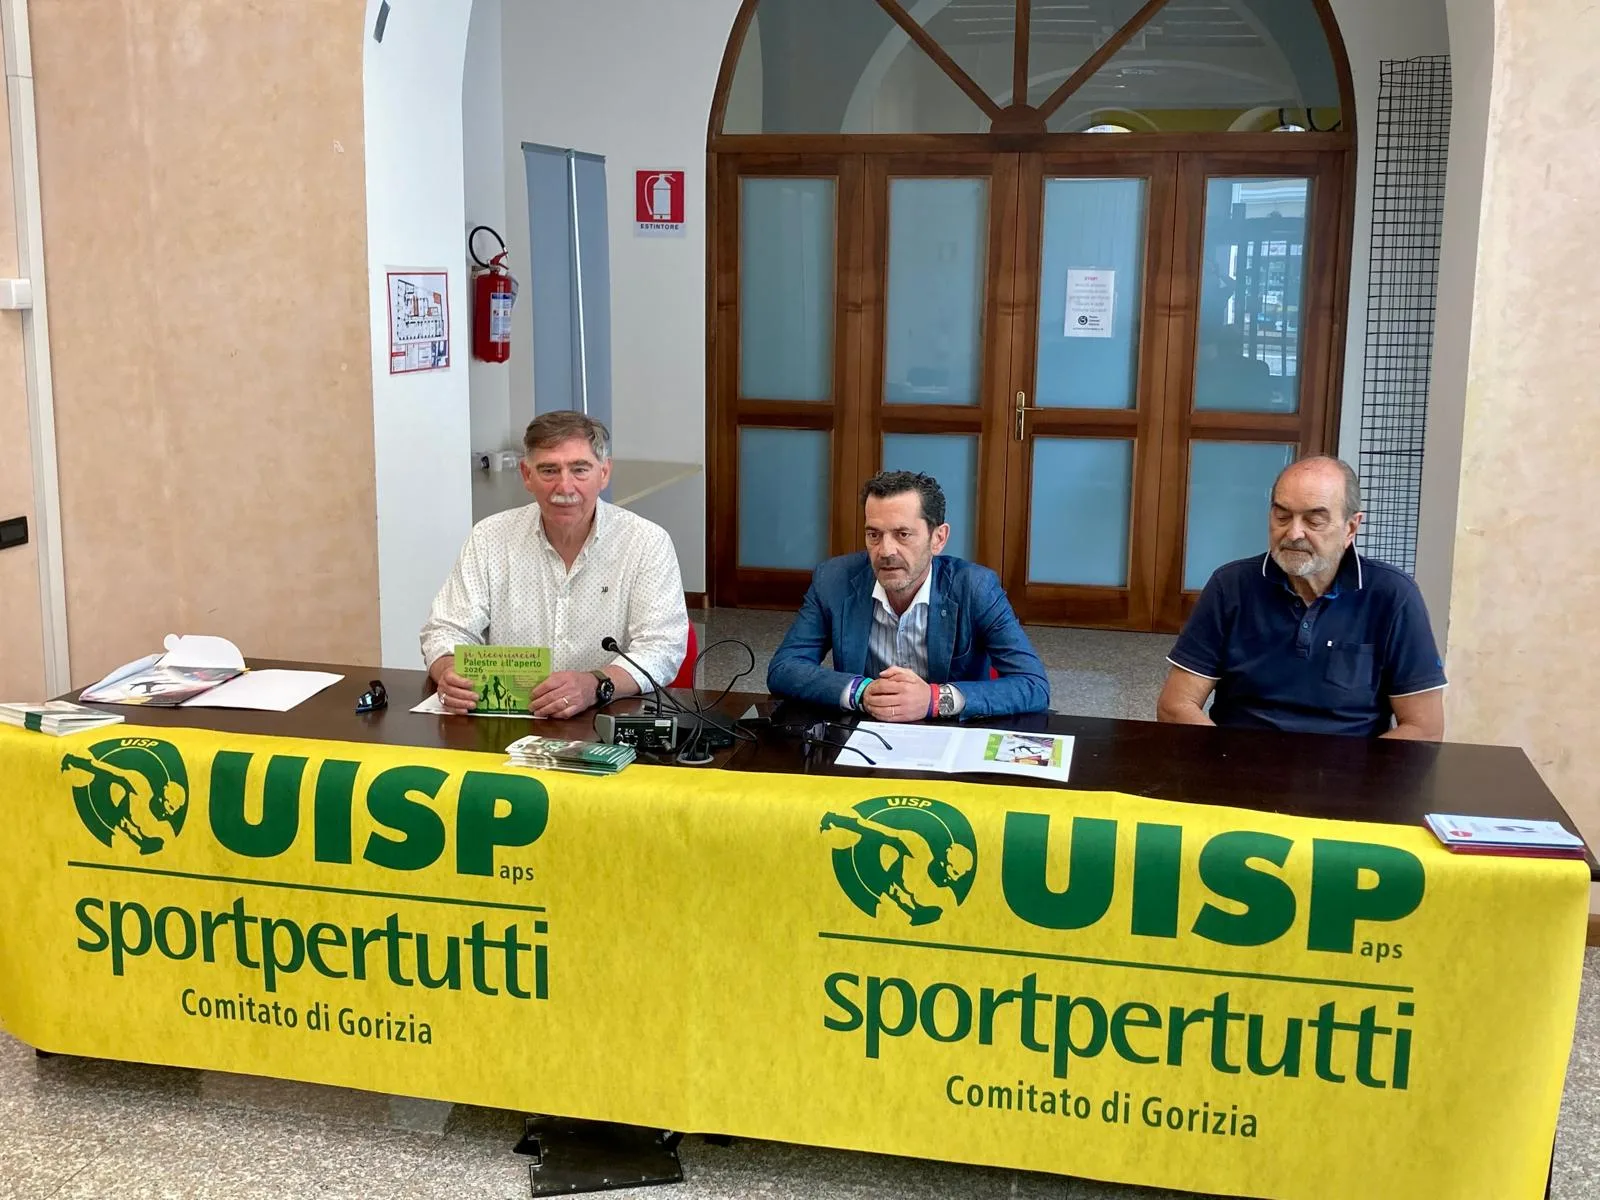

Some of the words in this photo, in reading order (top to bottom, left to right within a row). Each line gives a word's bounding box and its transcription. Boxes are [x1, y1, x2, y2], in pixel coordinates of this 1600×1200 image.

[463, 658, 498, 667] Palestre
[120, 739, 159, 747] UISP
[209, 751, 549, 876] UISP
[887, 798, 932, 808] UISP
[500, 866, 534, 884] aps
[1002, 812, 1425, 954] UISP
[76, 897, 549, 999] sportpertutti
[1361, 942, 1403, 963] aps
[182, 989, 297, 1028] Comitato
[307, 1002, 330, 1032] di
[339, 1008, 432, 1044] Gorizia
[824, 972, 1414, 1090] sportpertutti
[947, 1076, 1090, 1119] Comitato
[1102, 1091, 1131, 1123] di
[1142, 1097, 1257, 1137] Gorizia
